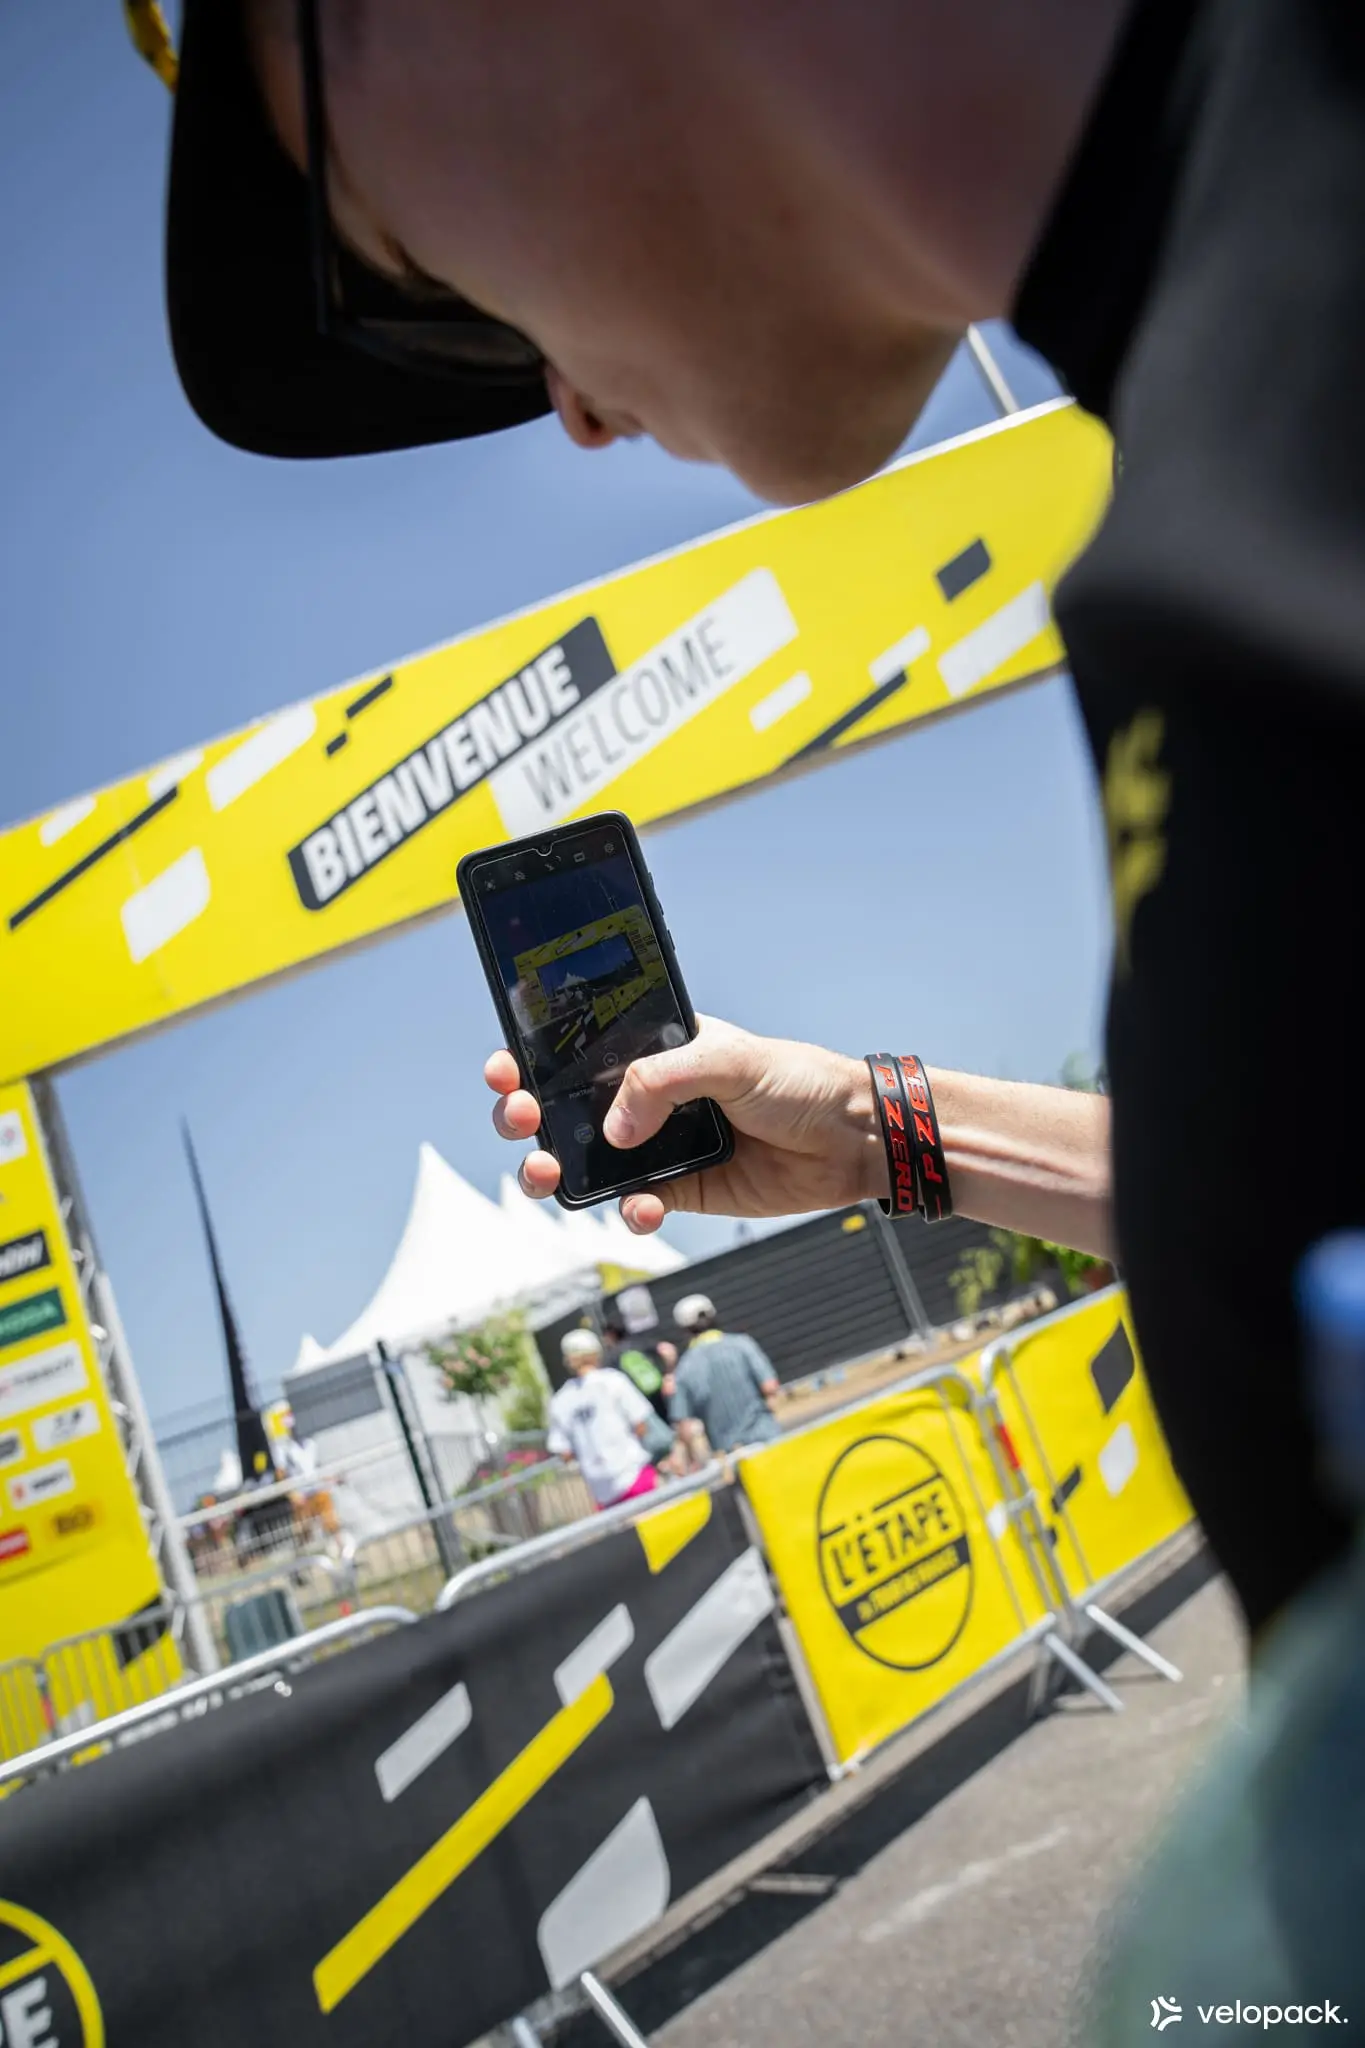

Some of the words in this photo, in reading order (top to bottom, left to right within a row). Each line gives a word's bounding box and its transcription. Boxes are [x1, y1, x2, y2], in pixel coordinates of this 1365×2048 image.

[302, 644, 581, 903] BIENVENUE
[521, 617, 738, 809] WELCOME
[883, 1095, 914, 1212] ZERO
